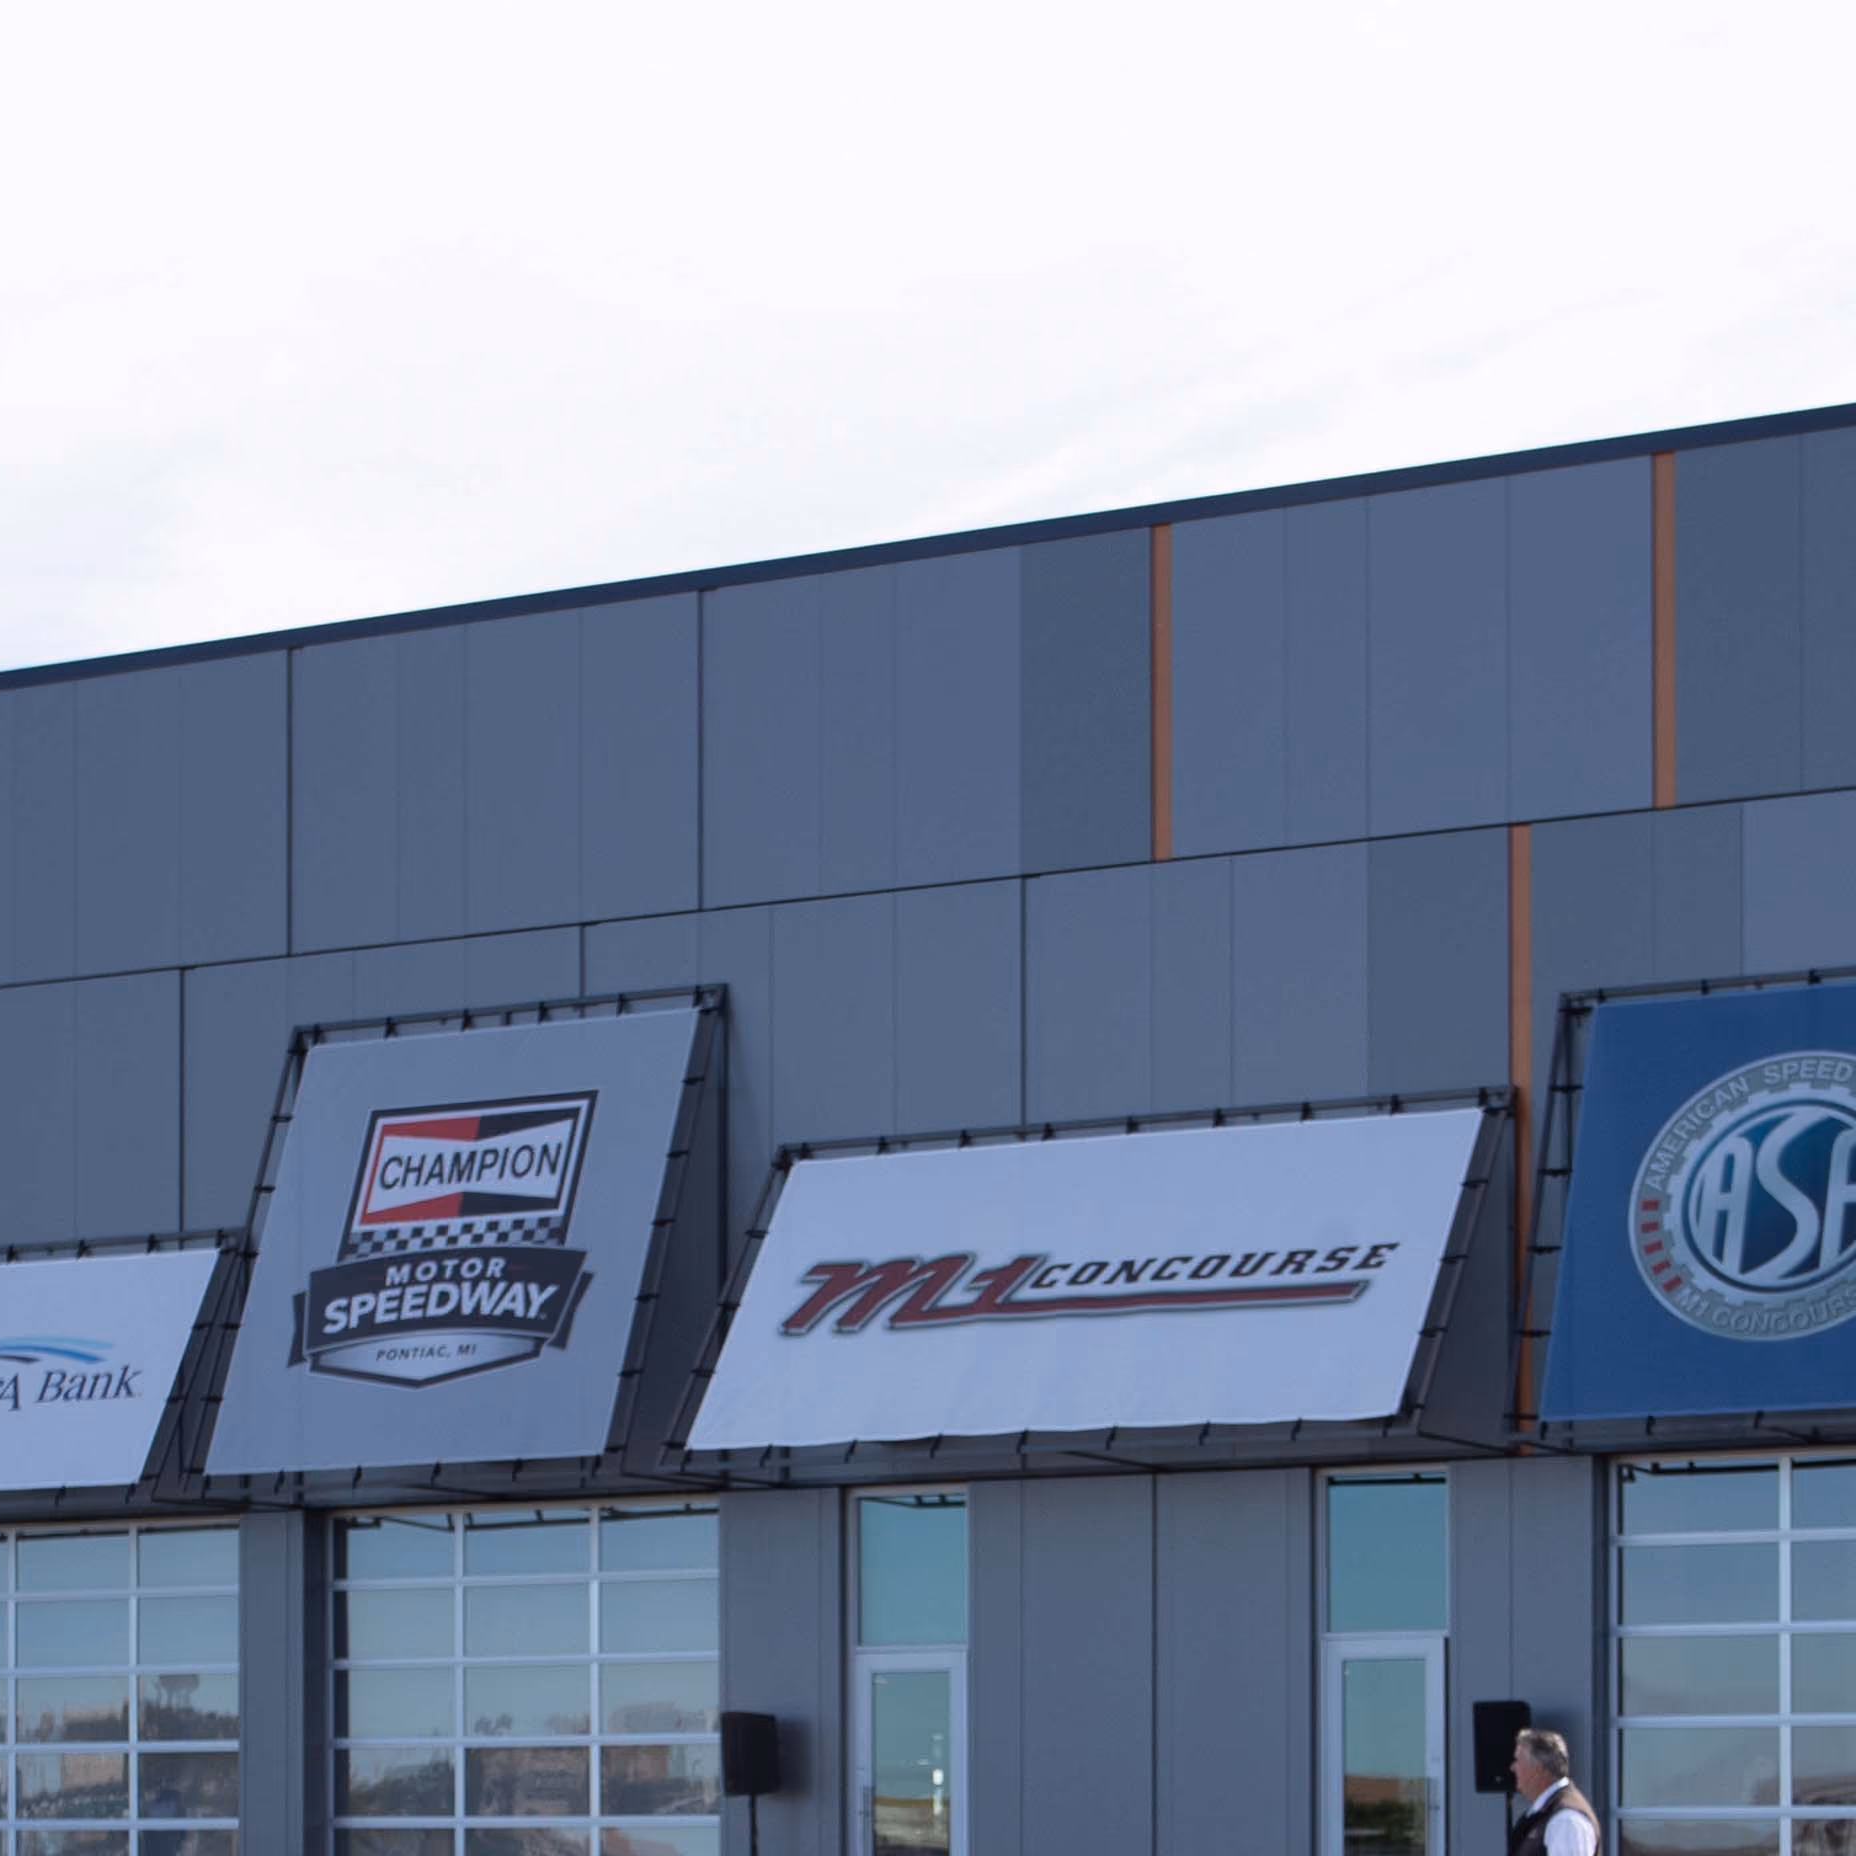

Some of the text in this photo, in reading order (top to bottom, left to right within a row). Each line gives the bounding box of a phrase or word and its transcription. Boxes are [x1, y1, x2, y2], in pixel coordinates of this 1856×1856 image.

[1647, 1076, 1751, 1190] AMERICAN
[1763, 1059, 1853, 1086] SPEED
[379, 1141, 562, 1191] CHAMPION
[385, 1257, 507, 1286] MOTOR
[778, 1243, 1400, 1336] M1 CONCOURSE
[321, 1281, 558, 1335] SPEEDWAY
[376, 1343, 477, 1361] PONTIAC, MI
[35, 1363, 140, 1404] Bank
